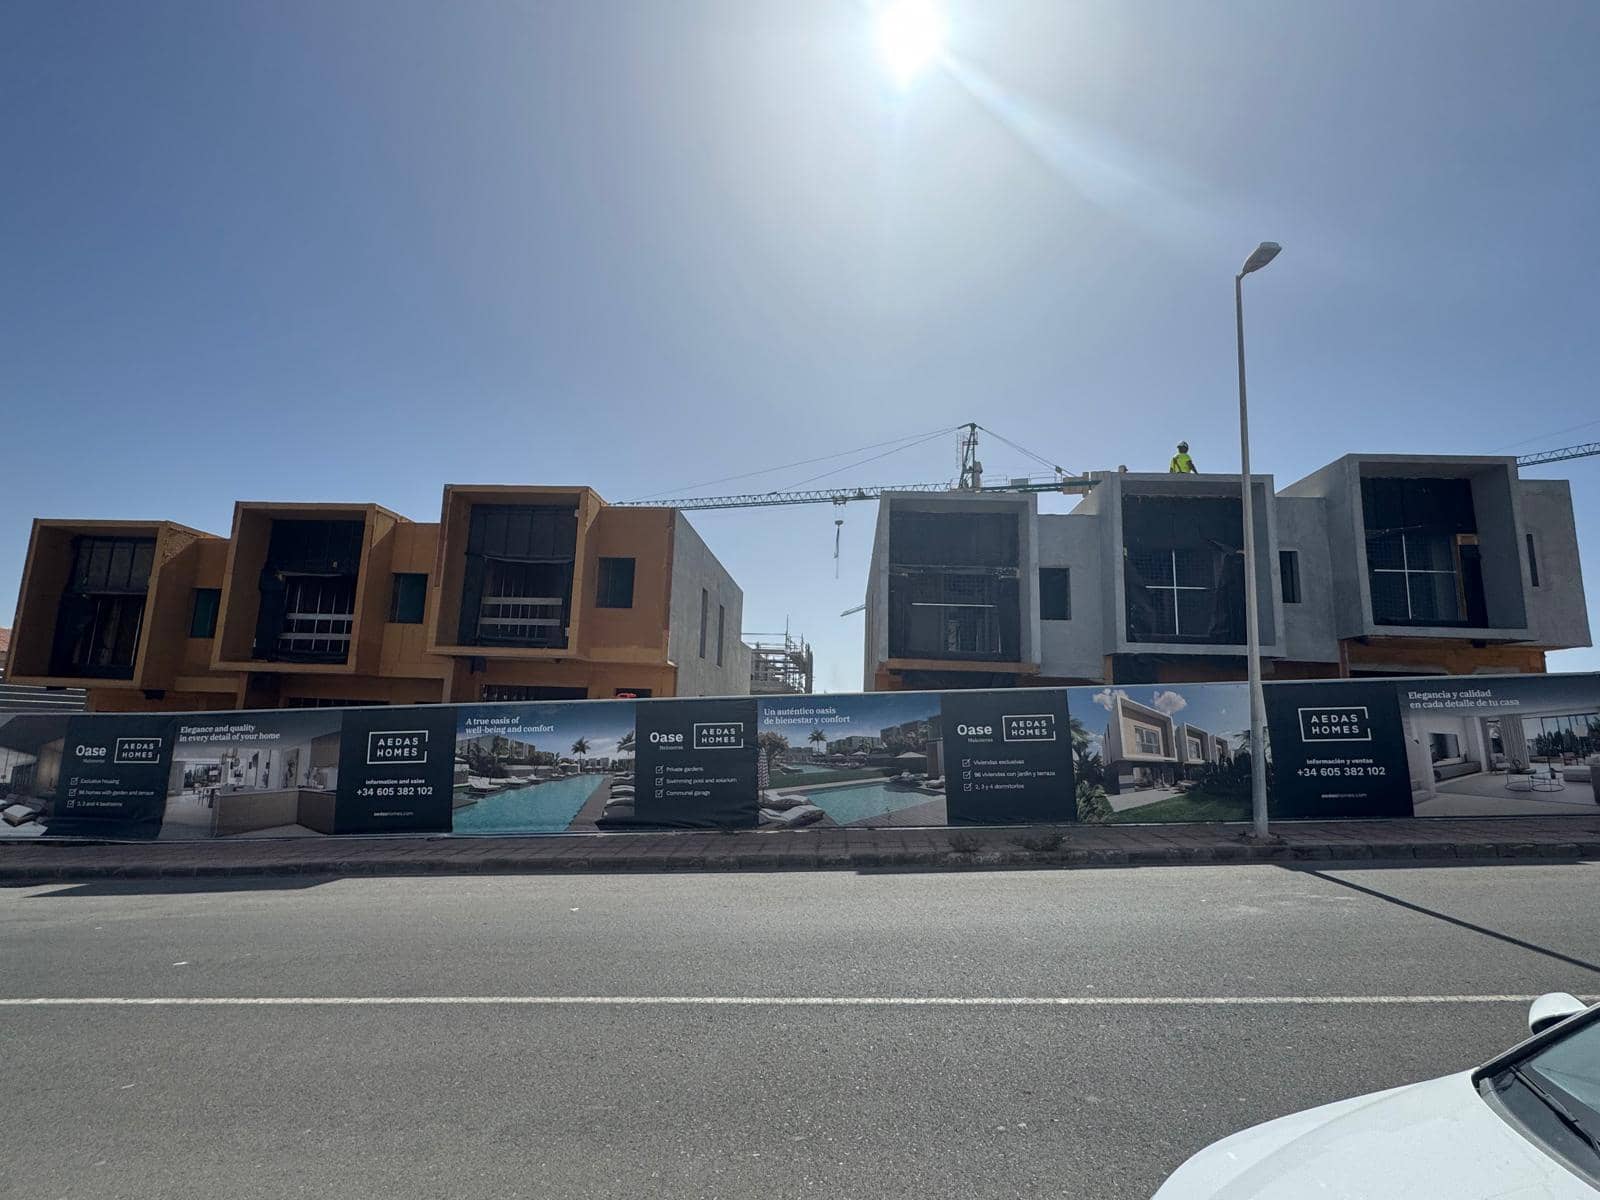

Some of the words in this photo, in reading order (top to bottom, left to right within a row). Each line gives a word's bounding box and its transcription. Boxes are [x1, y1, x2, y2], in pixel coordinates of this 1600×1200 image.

[1408, 690, 1452, 700] Elegancia
[1451, 692, 1458, 700] y
[1458, 688, 1492, 698] calidad
[1422, 700, 1444, 708] cada
[1444, 699, 1475, 708] detalle
[1476, 698, 1488, 706] de
[776, 706, 814, 715] auténtico
[490, 716, 510, 724] oasis
[511, 716, 520, 724] of
[1010, 720, 1047, 728] AEDAS
[1310, 714, 1358, 724] AEDAS
[180, 726, 214, 734] Elegance
[214, 724, 229, 732] and
[230, 724, 256, 733] quality
[465, 726, 506, 734] well-being
[523, 724, 554, 732] comfort
[957, 724, 992, 736] Oase
[1312, 725, 1360, 734] HOMES
[210, 732, 230, 740] detail
[259, 732, 280, 740] home
[650, 732, 684, 743] Oase
[378, 737, 418, 746] AEDAS
[76, 744, 106, 756] Oase
[376, 748, 418, 757] HOMES
[1297, 768, 1318, 776] +34
[1320, 767, 1340, 776] 605
[1344, 767, 1364, 776] 382
[1366, 766, 1386, 776] 102
[356, 788, 374, 796] +34
[376, 787, 394, 796] 605
[396, 786, 414, 796] 382
[416, 786, 433, 795] 102
